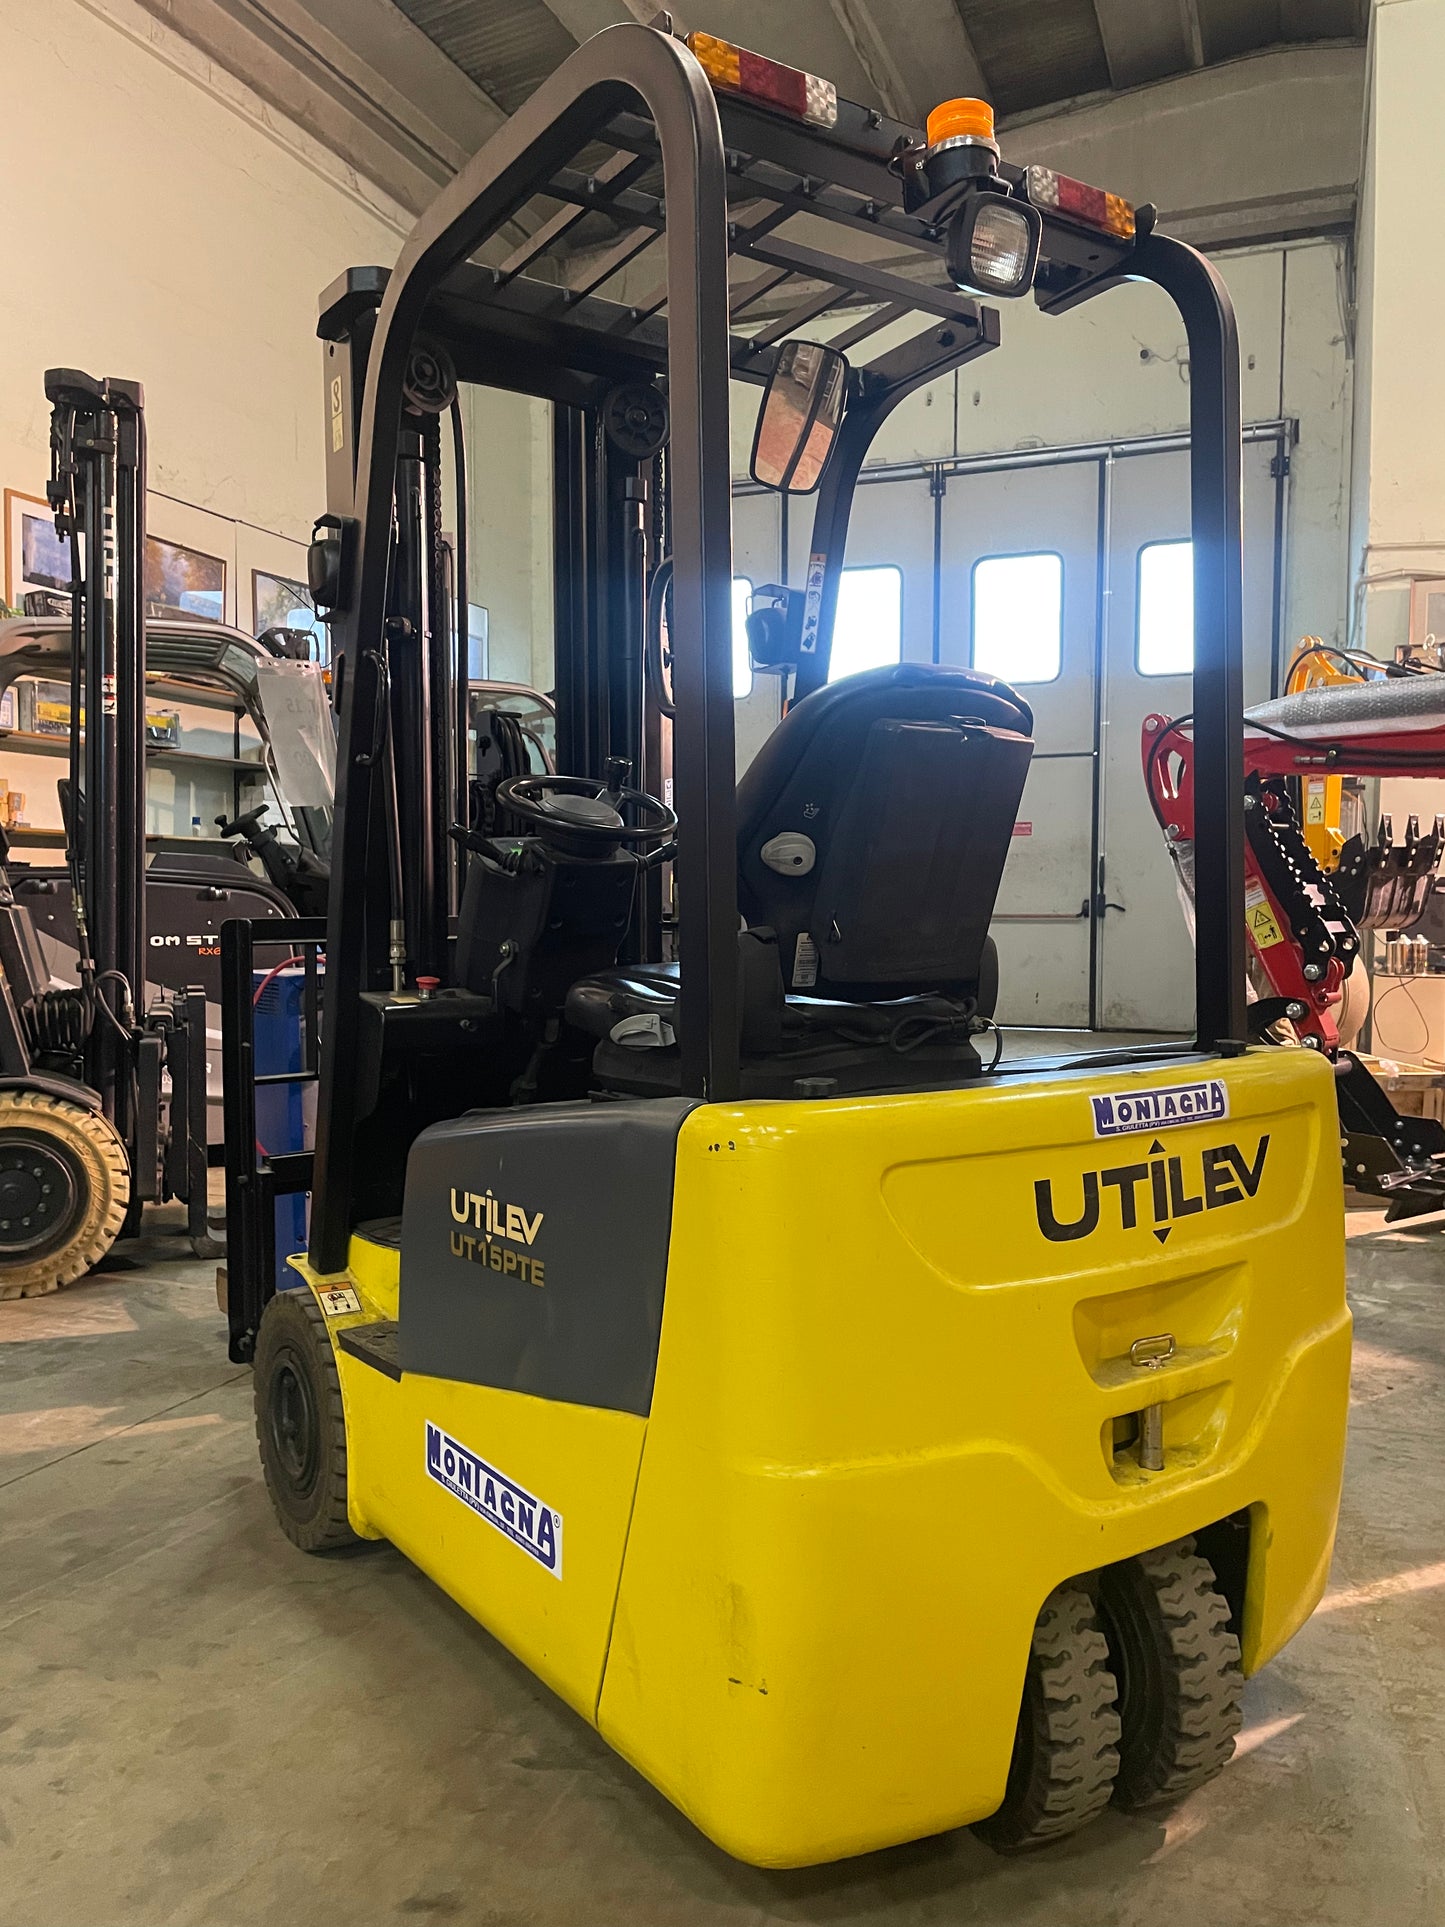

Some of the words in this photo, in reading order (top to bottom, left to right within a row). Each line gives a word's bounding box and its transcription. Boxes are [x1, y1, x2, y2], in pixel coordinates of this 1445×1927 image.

[150, 935, 180, 947] OM
[1092, 1082, 1225, 1128] MONTAGNA
[450, 1187, 544, 1246] UTILEV
[1034, 1134, 1271, 1245] UTILEV
[450, 1230, 545, 1287] UT15PTE
[427, 1424, 556, 1556] MONTAGNA
